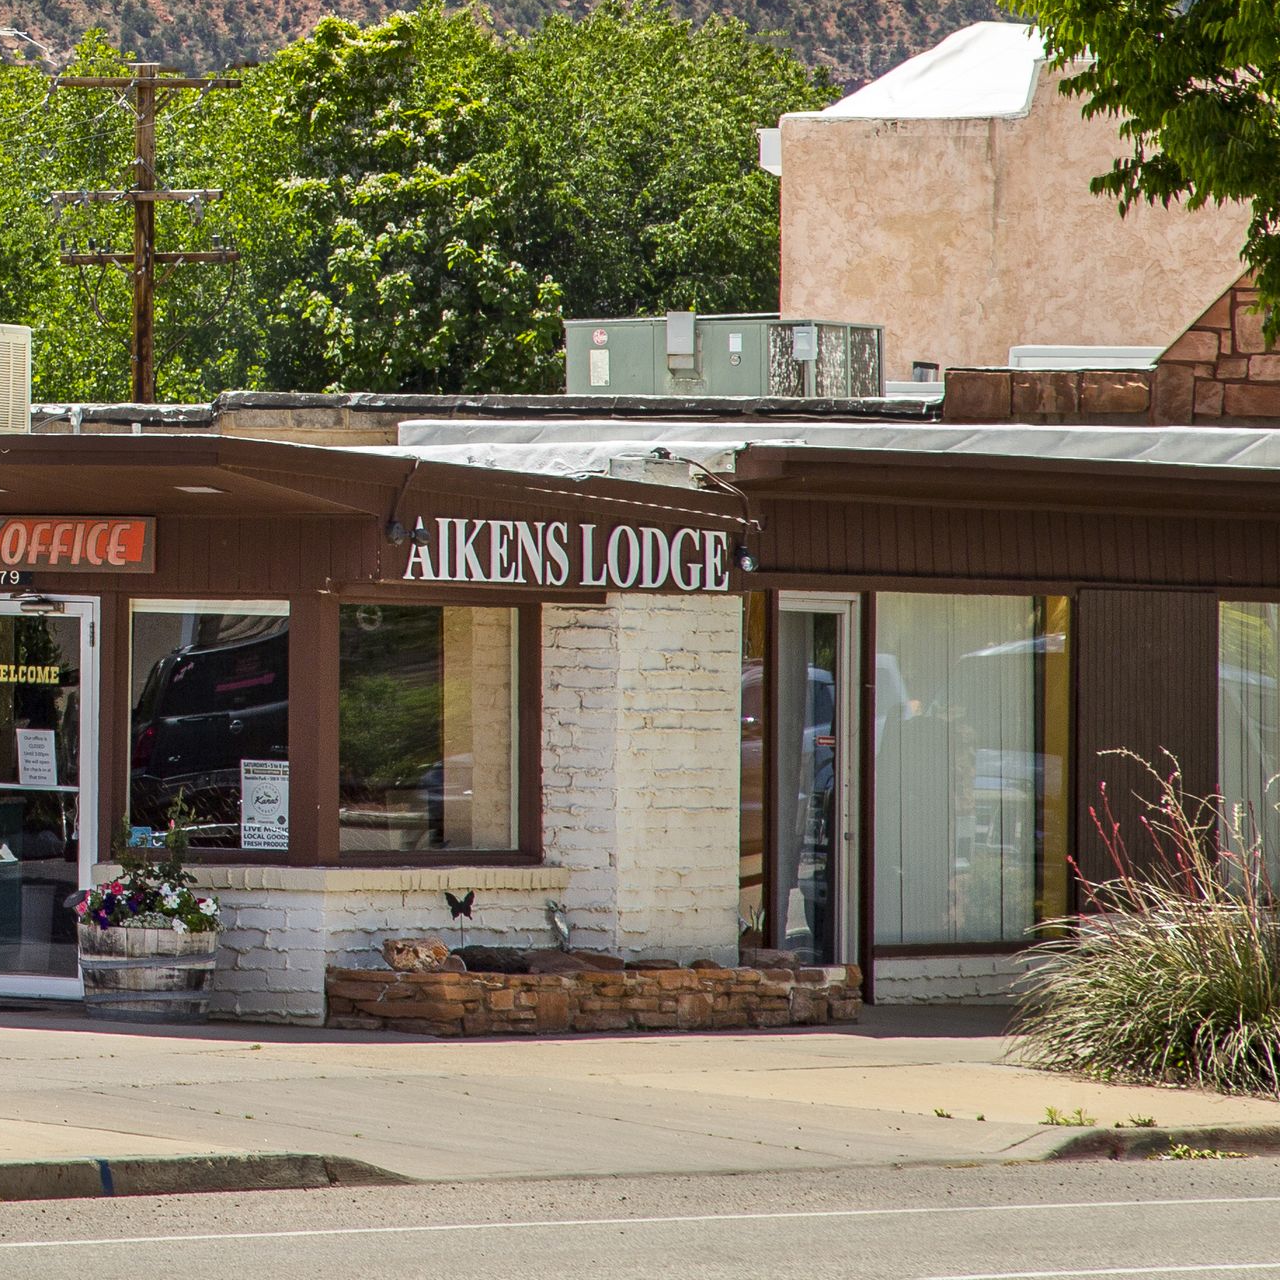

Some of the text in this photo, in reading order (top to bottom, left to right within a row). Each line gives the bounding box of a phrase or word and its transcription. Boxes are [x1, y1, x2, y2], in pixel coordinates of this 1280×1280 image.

[1, 522, 131, 566] OFFICE
[402, 516, 729, 591] AIKENS LODGE
[254, 795, 279, 805] Kanab
